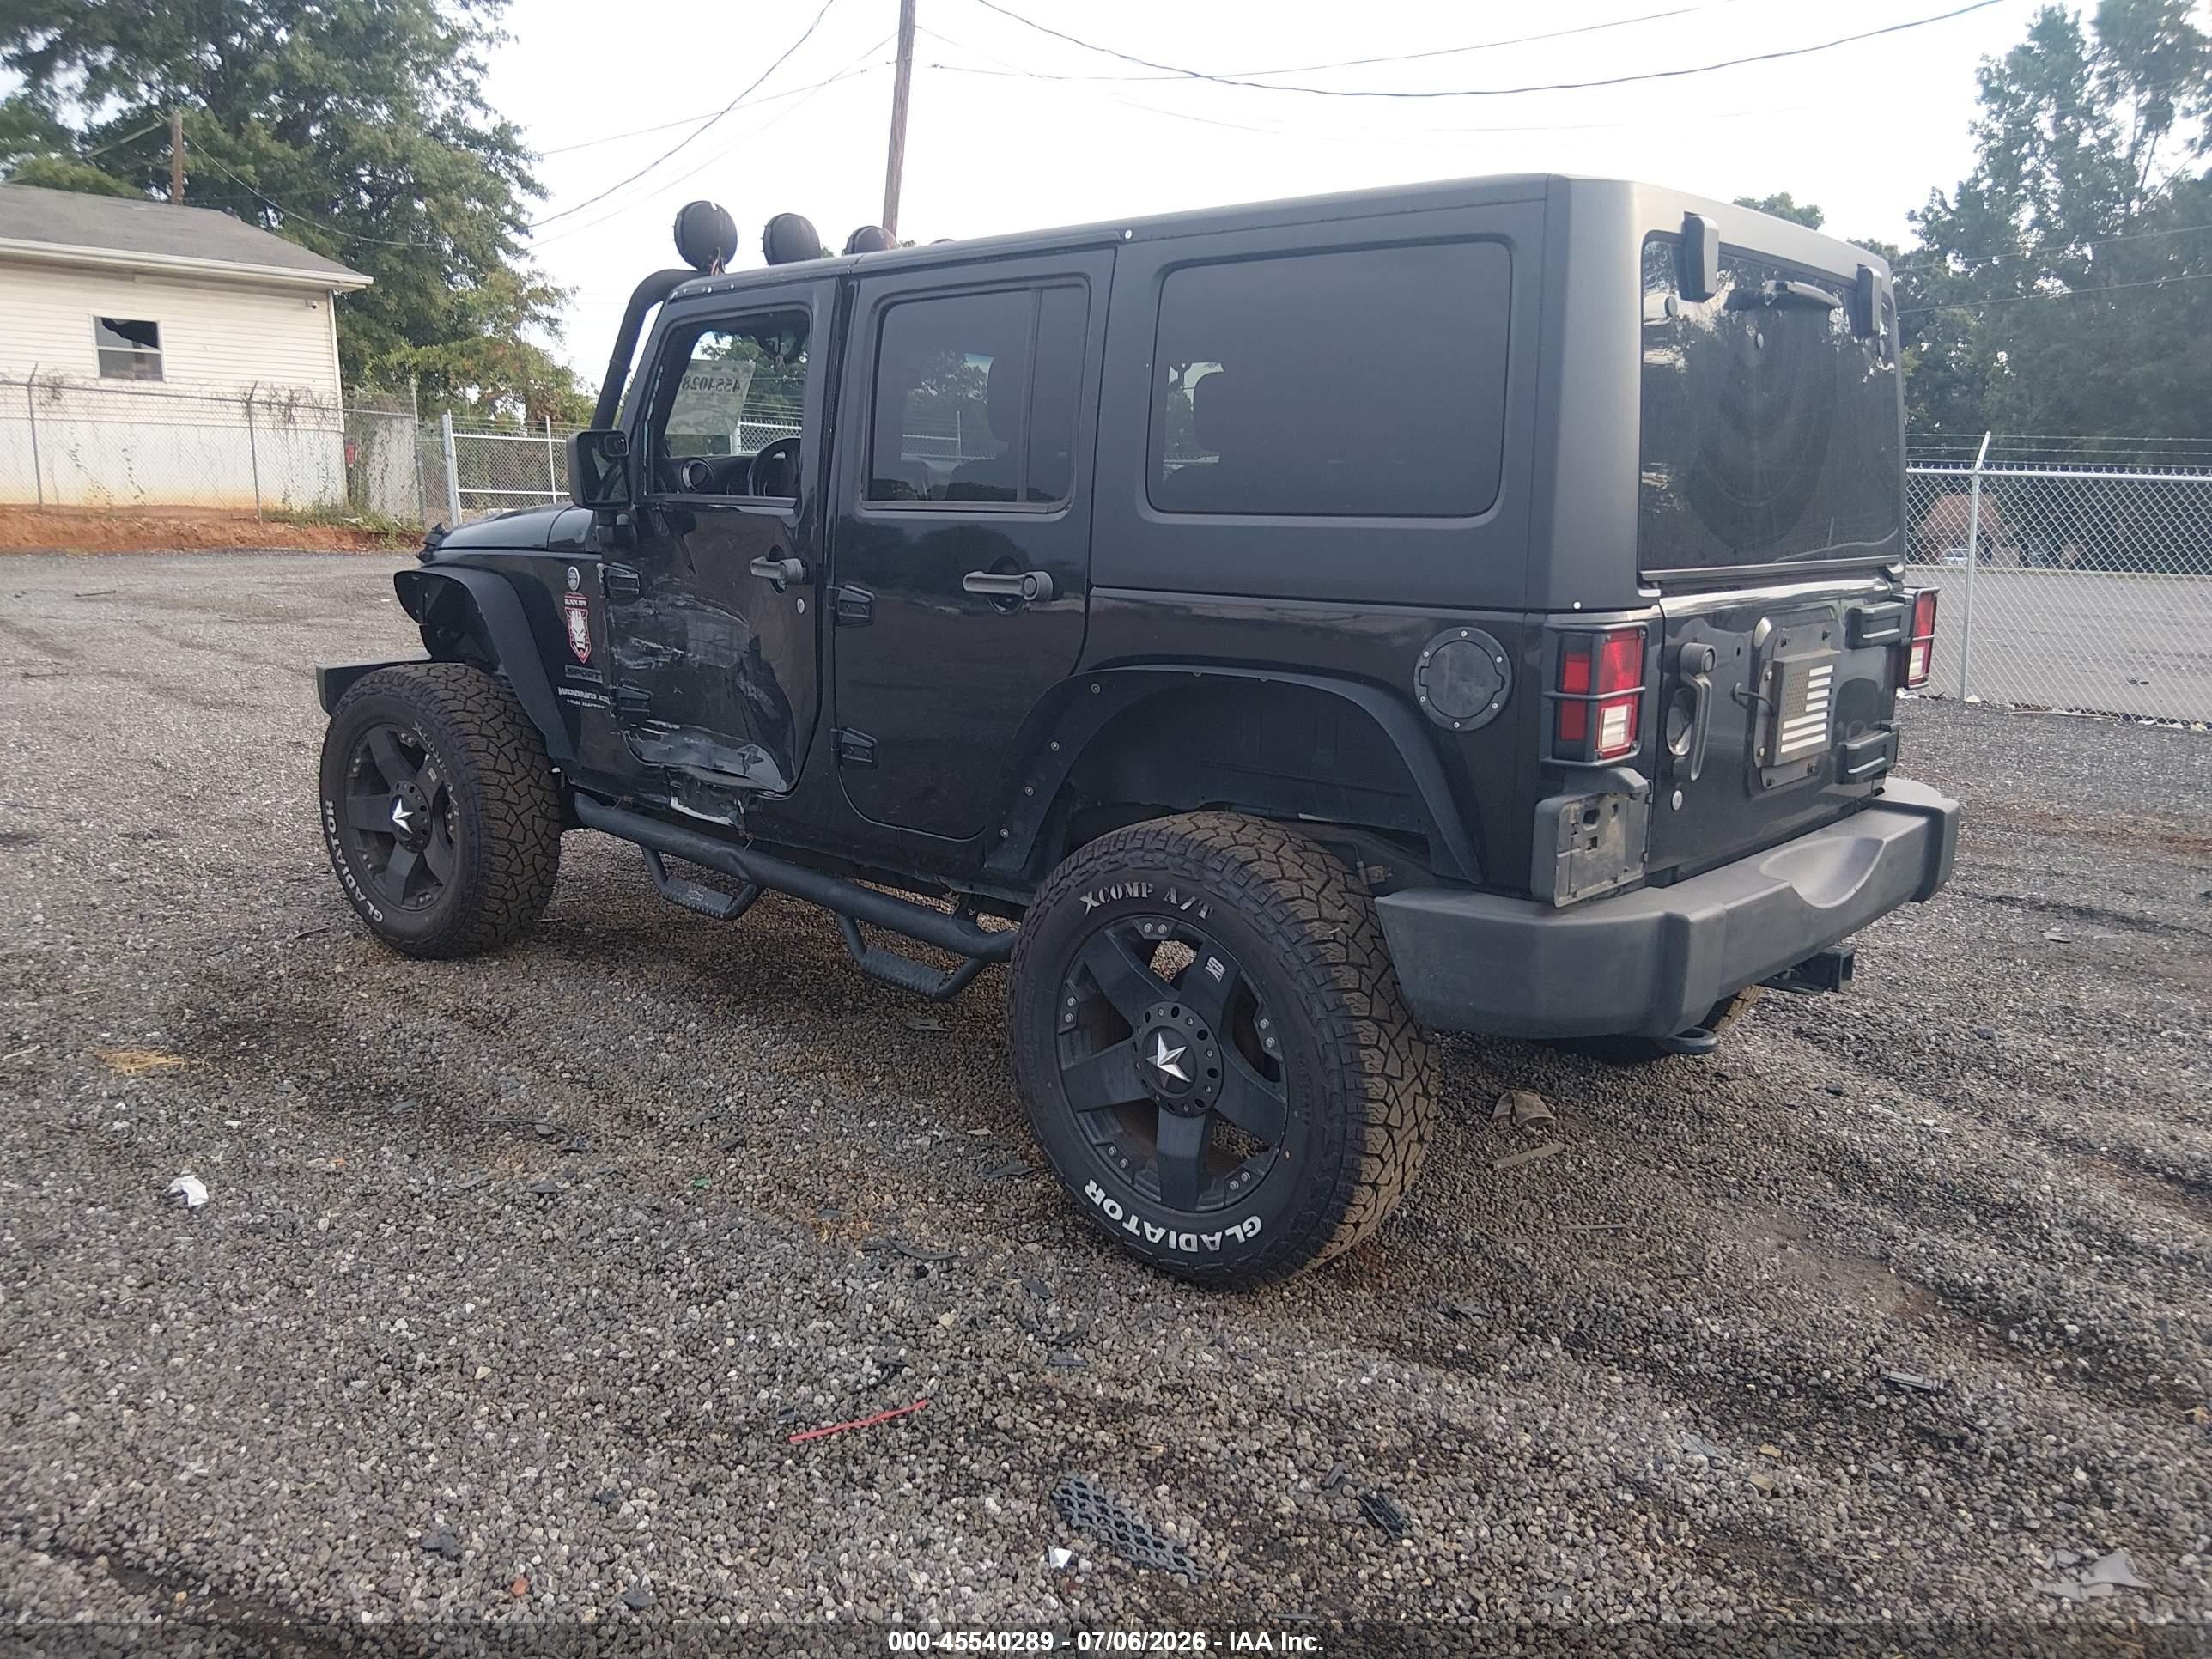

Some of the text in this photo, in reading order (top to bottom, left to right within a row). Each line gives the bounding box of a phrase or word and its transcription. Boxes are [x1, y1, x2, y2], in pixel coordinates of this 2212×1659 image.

[568, 667, 599, 679] SPORT
[324, 799, 385, 923] GLADIATOR
[1079, 881, 1214, 920] XCOMP A/T
[1084, 1177, 1264, 1255] GLADIATOR
